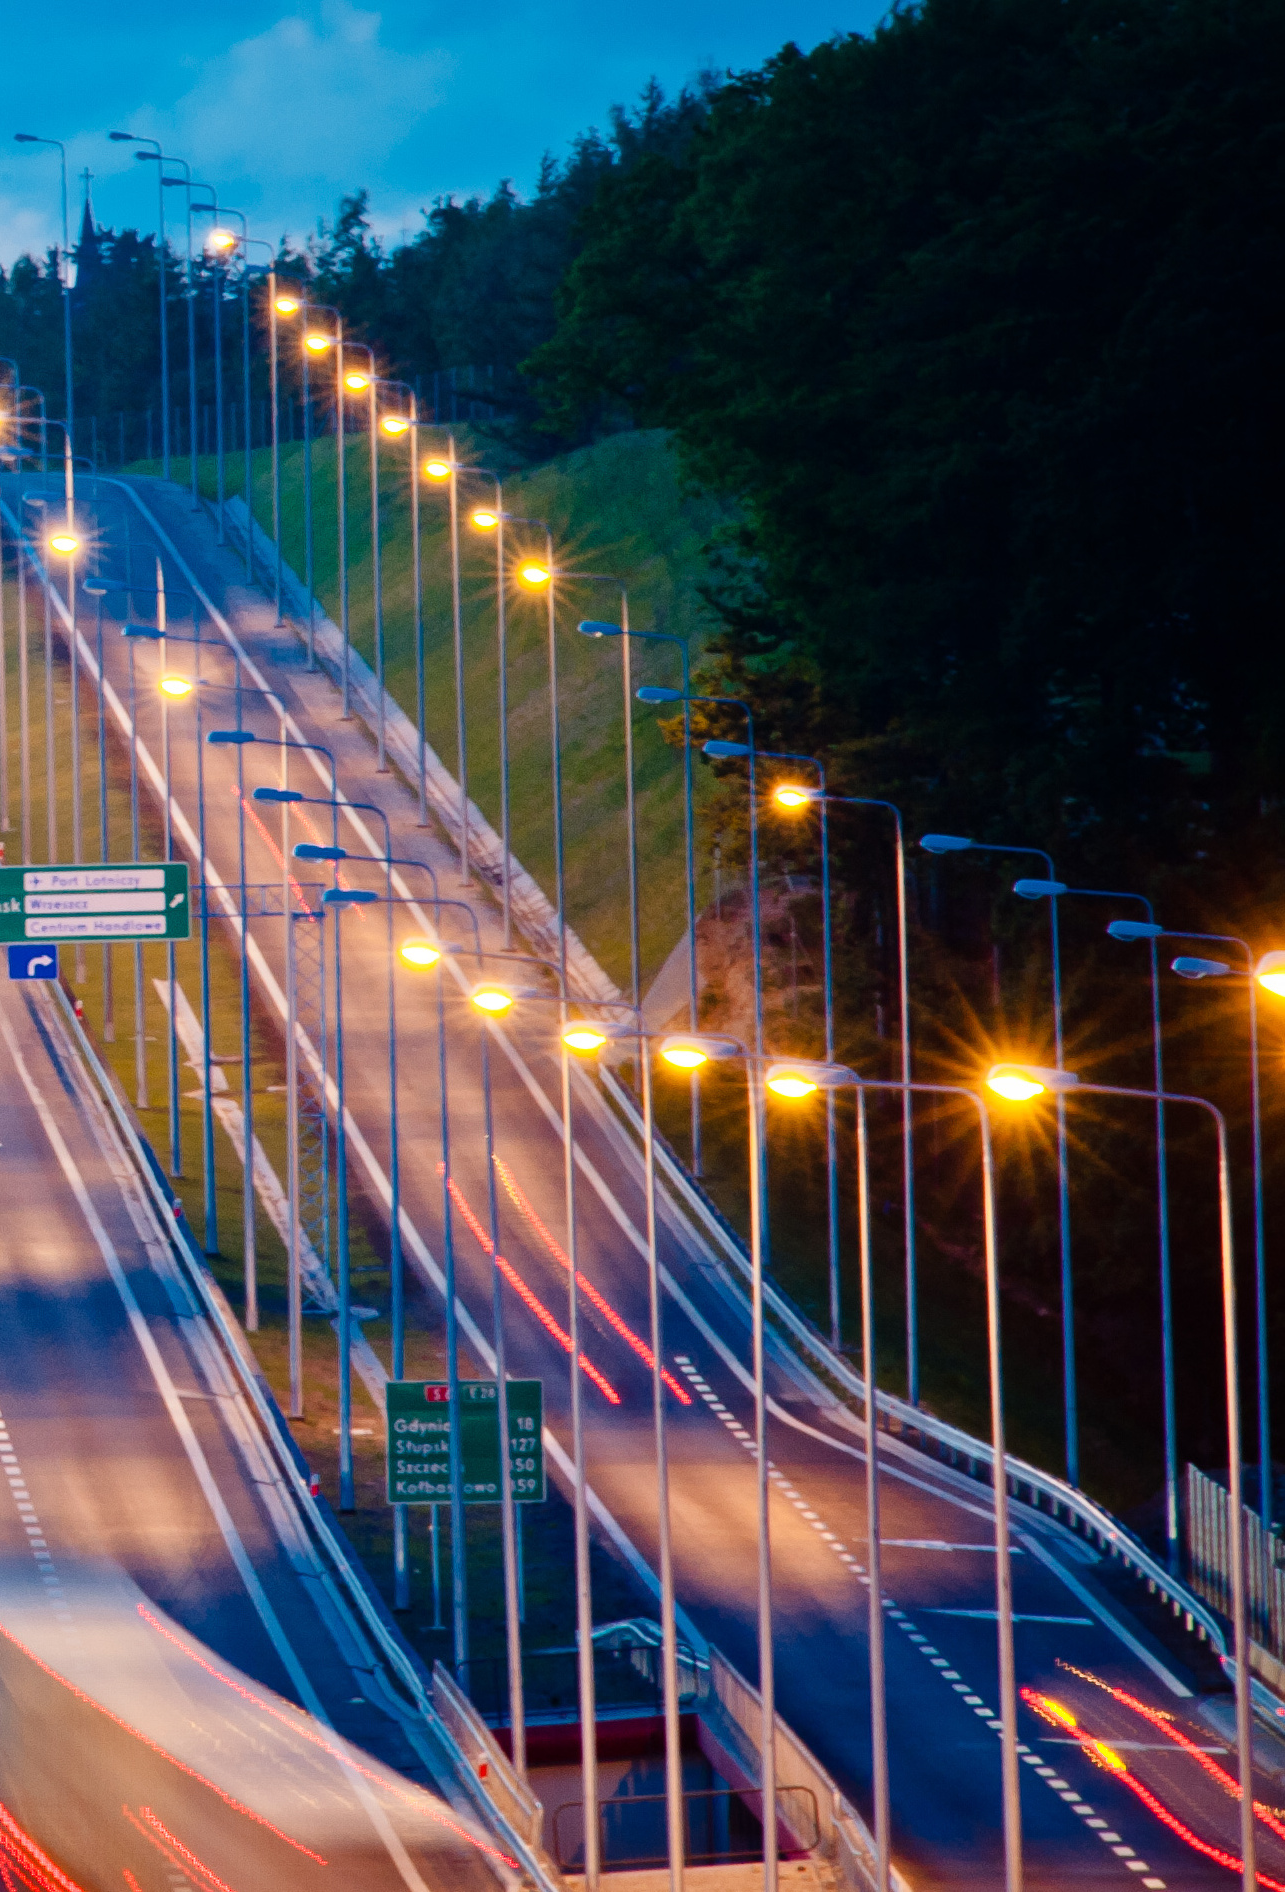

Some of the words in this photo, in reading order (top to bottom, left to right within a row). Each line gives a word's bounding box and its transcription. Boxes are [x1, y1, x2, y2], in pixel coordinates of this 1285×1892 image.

[51, 876, 79, 887] Port
[85, 875, 140, 889] Lotniczy
[30, 899, 88, 910] Wrzeszcz
[30, 922, 87, 933] Centrum
[94, 918, 162, 931] Handlowe
[516, 1417, 535, 1431] 18
[511, 1437, 536, 1452] 127
[509, 1458, 535, 1472] 50
[510, 1478, 536, 1493] 59
